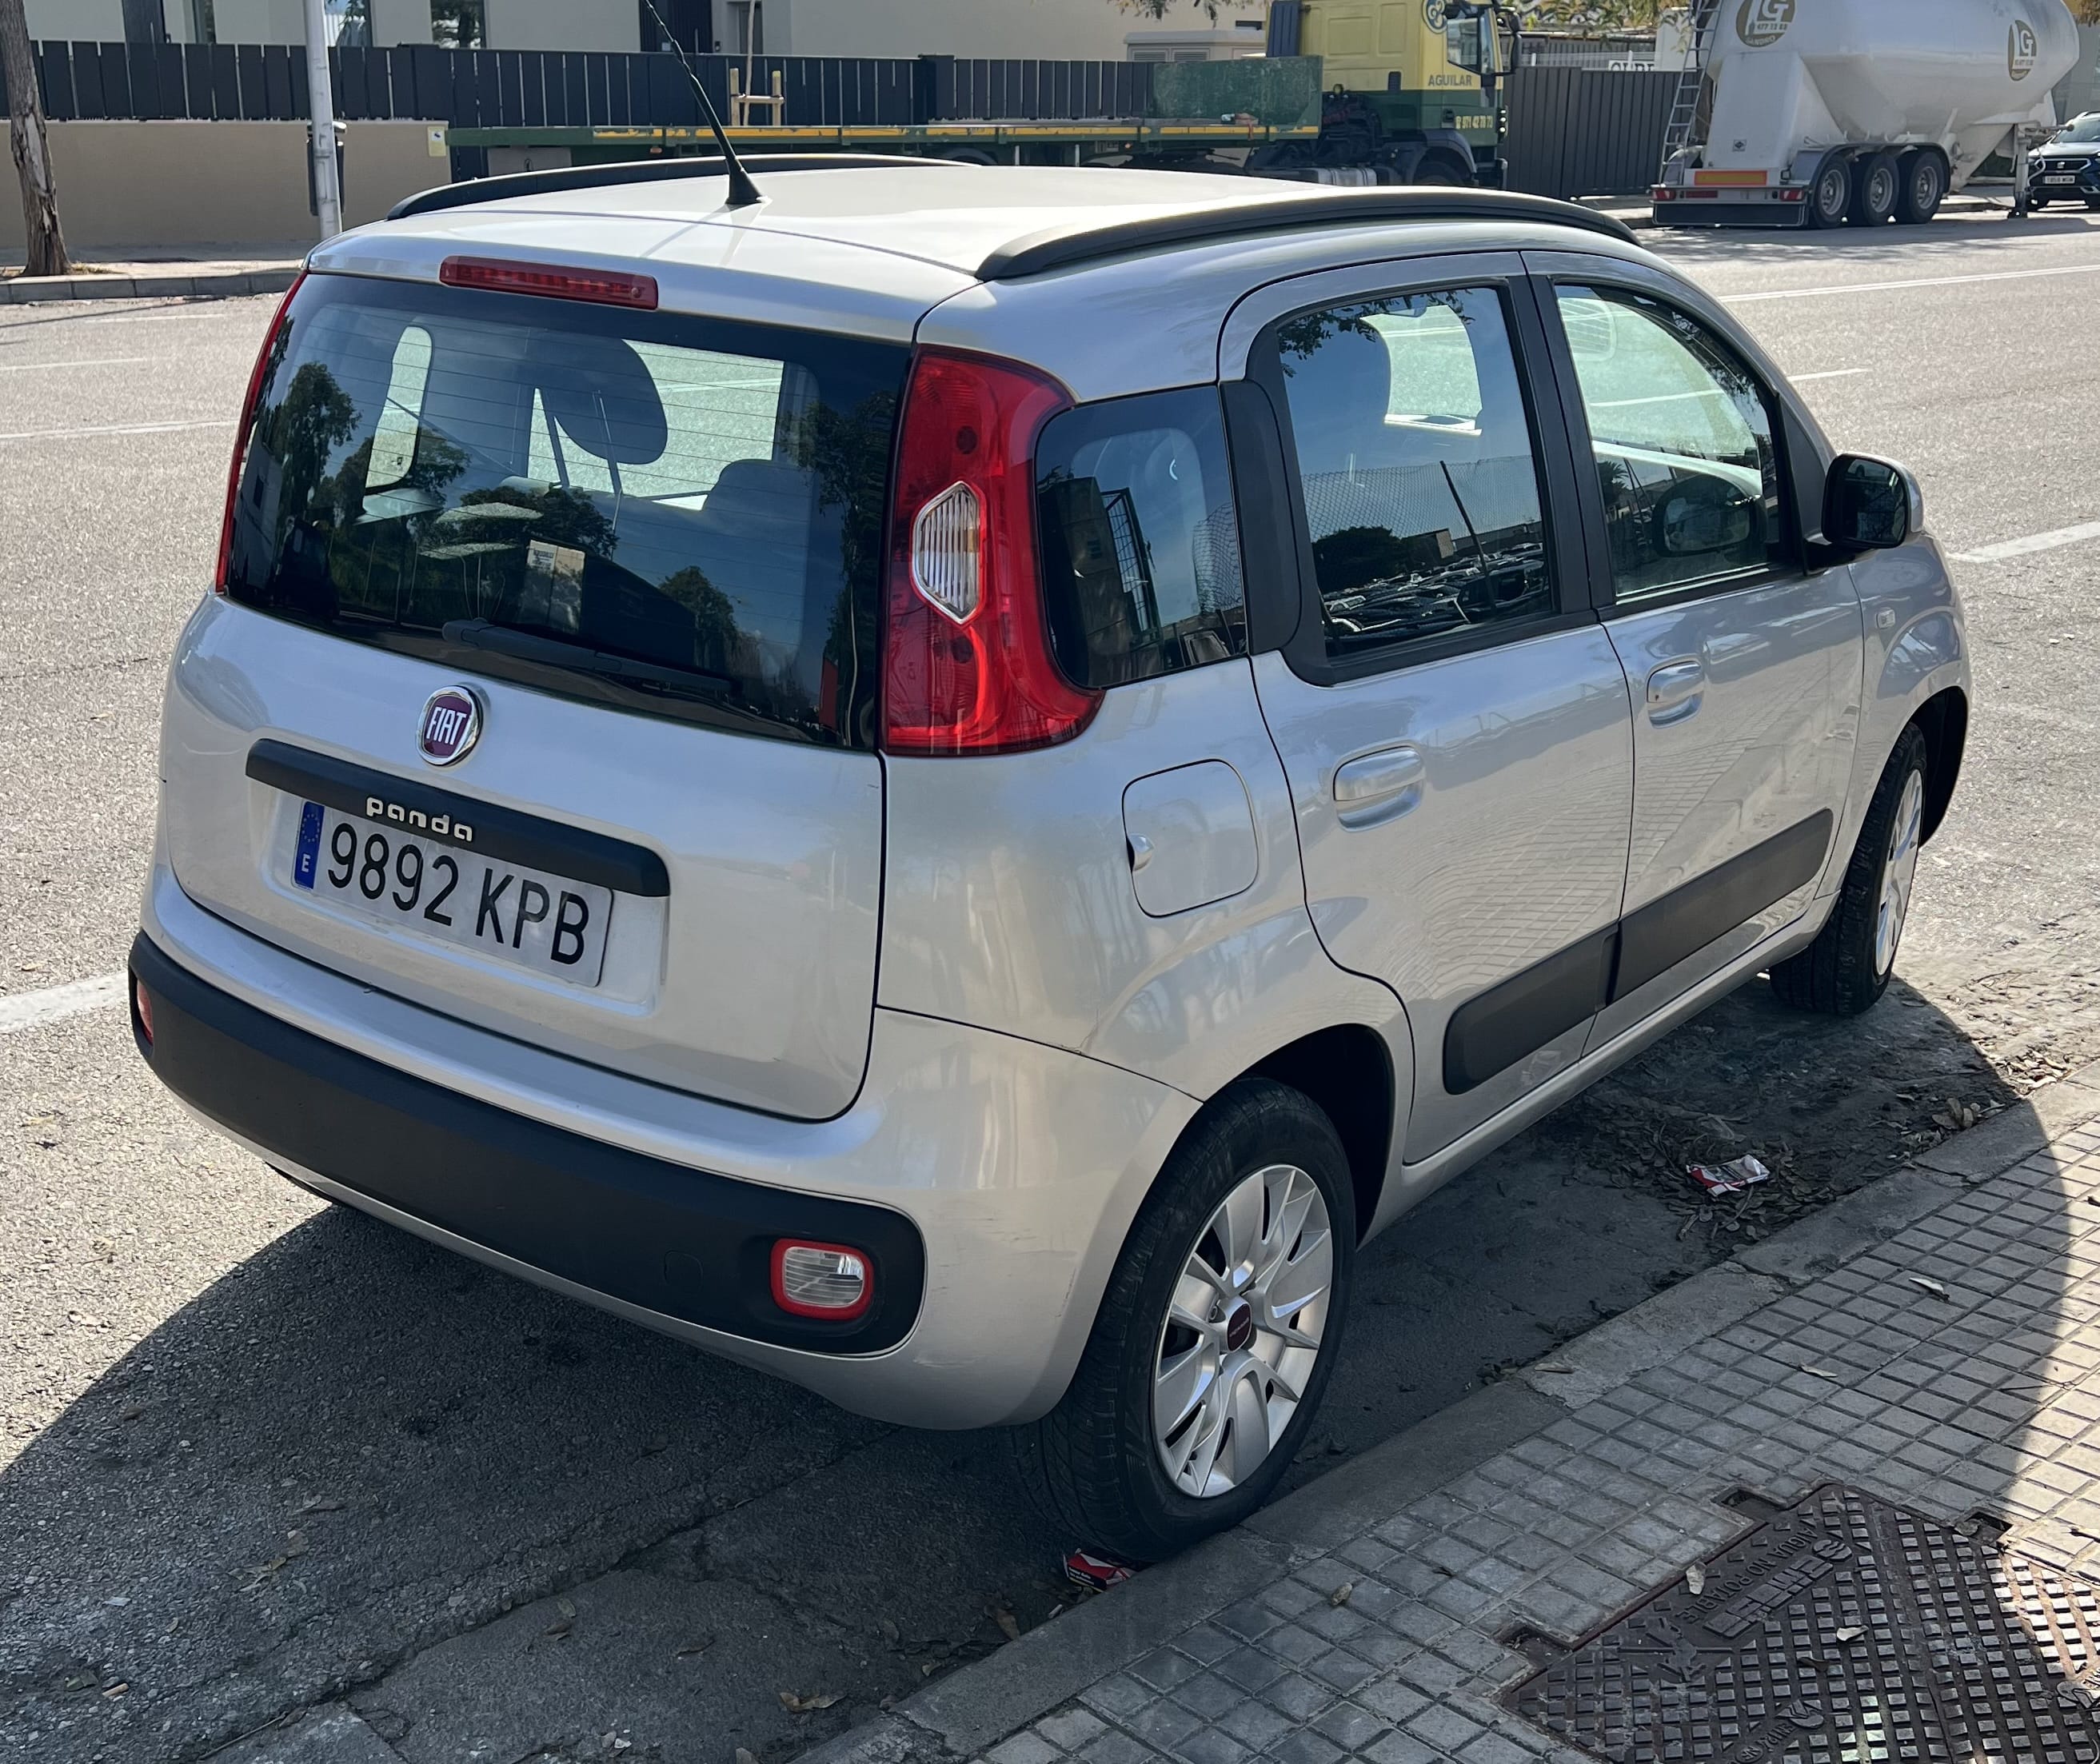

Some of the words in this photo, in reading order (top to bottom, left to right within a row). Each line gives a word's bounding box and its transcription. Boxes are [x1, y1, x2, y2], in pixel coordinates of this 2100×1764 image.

[1428, 74, 1472, 86] AGUILAR
[426, 706, 468, 745] FIAT
[366, 796, 473, 842] panda
[301, 853, 311, 873] E
[328, 823, 459, 927] 9892
[475, 868, 589, 965] KPB
[1767, 1527, 1818, 1558] AIGUA
[1746, 1558, 1777, 1576] NO
[1675, 1574, 1754, 1624] POTABLE
